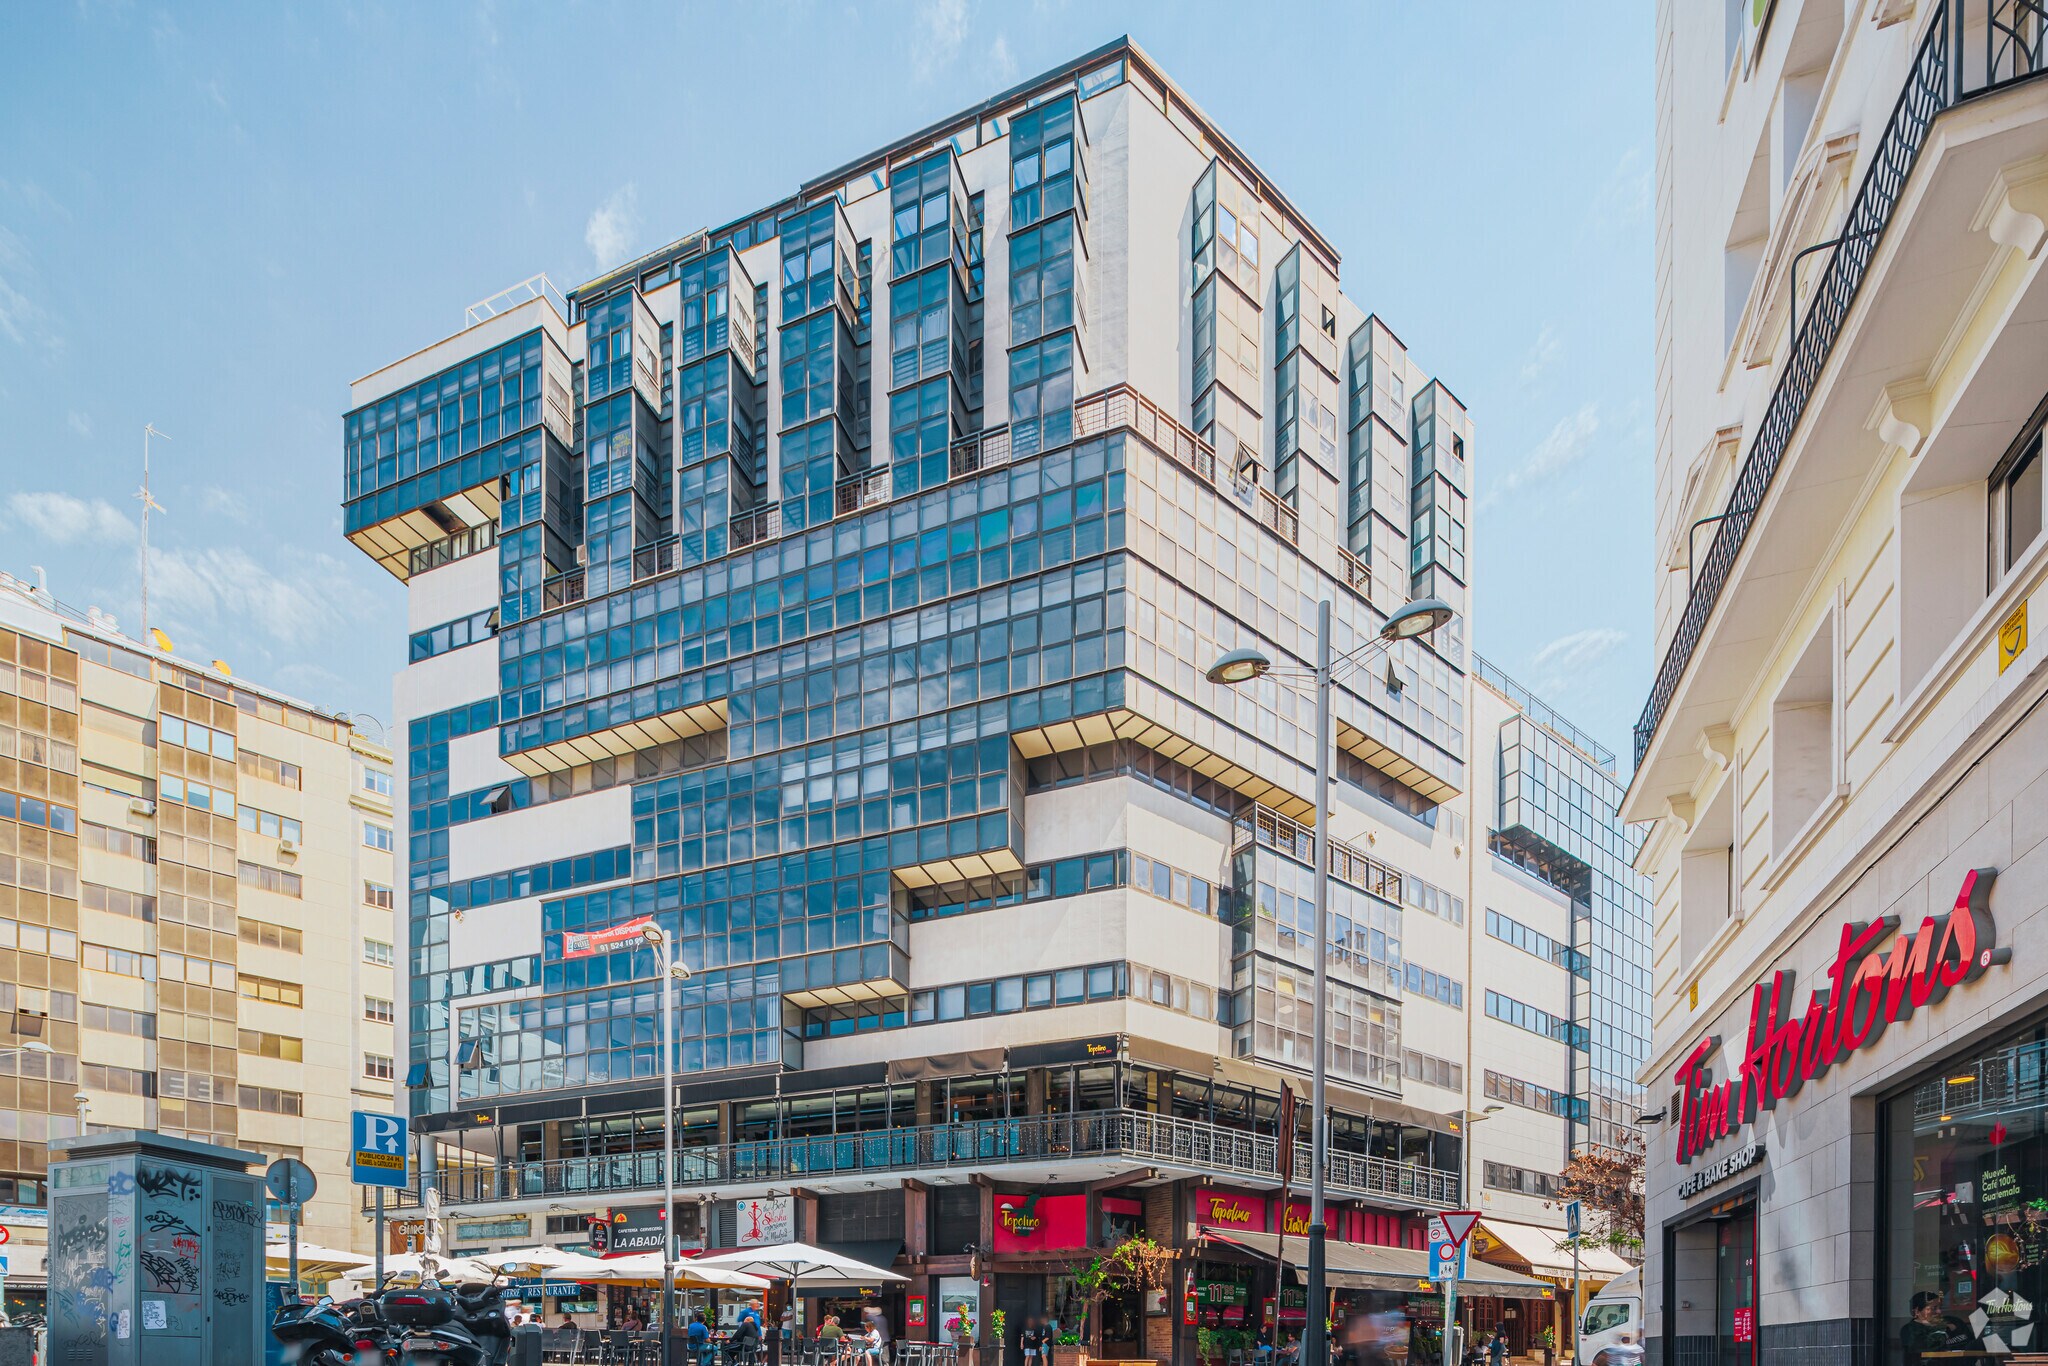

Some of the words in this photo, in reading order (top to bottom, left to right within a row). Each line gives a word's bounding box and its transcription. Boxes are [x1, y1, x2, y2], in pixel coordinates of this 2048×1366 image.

[600, 944, 609, 952] 91
[610, 941, 624, 950] 524
[625, 939, 634, 947] 10
[1674, 1035, 1734, 1166] Tim
[1738, 868, 1986, 1125] Hortons
[1087, 1043, 1107, 1056] Topolino
[362, 1115, 399, 1151] P
[358, 1151, 386, 1161] PUBLICO
[1704, 1159, 1728, 1187] BAKE
[1728, 1143, 1757, 1175] SHOP
[1982, 1179, 1998, 1192] Café
[1999, 1174, 2017, 1187] 100%
[1001, 1210, 1040, 1234] Topolino
[1209, 1198, 1252, 1225] Topolino
[1283, 1204, 1329, 1235] Gard
[614, 1238, 627, 1248] LA
[628, 1233, 666, 1248] ABADÍA
[527, 1285, 576, 1297] RESTAURANTE
[1985, 1299, 2000, 1315] Tim
[2001, 1297, 2033, 1313] Hortons
